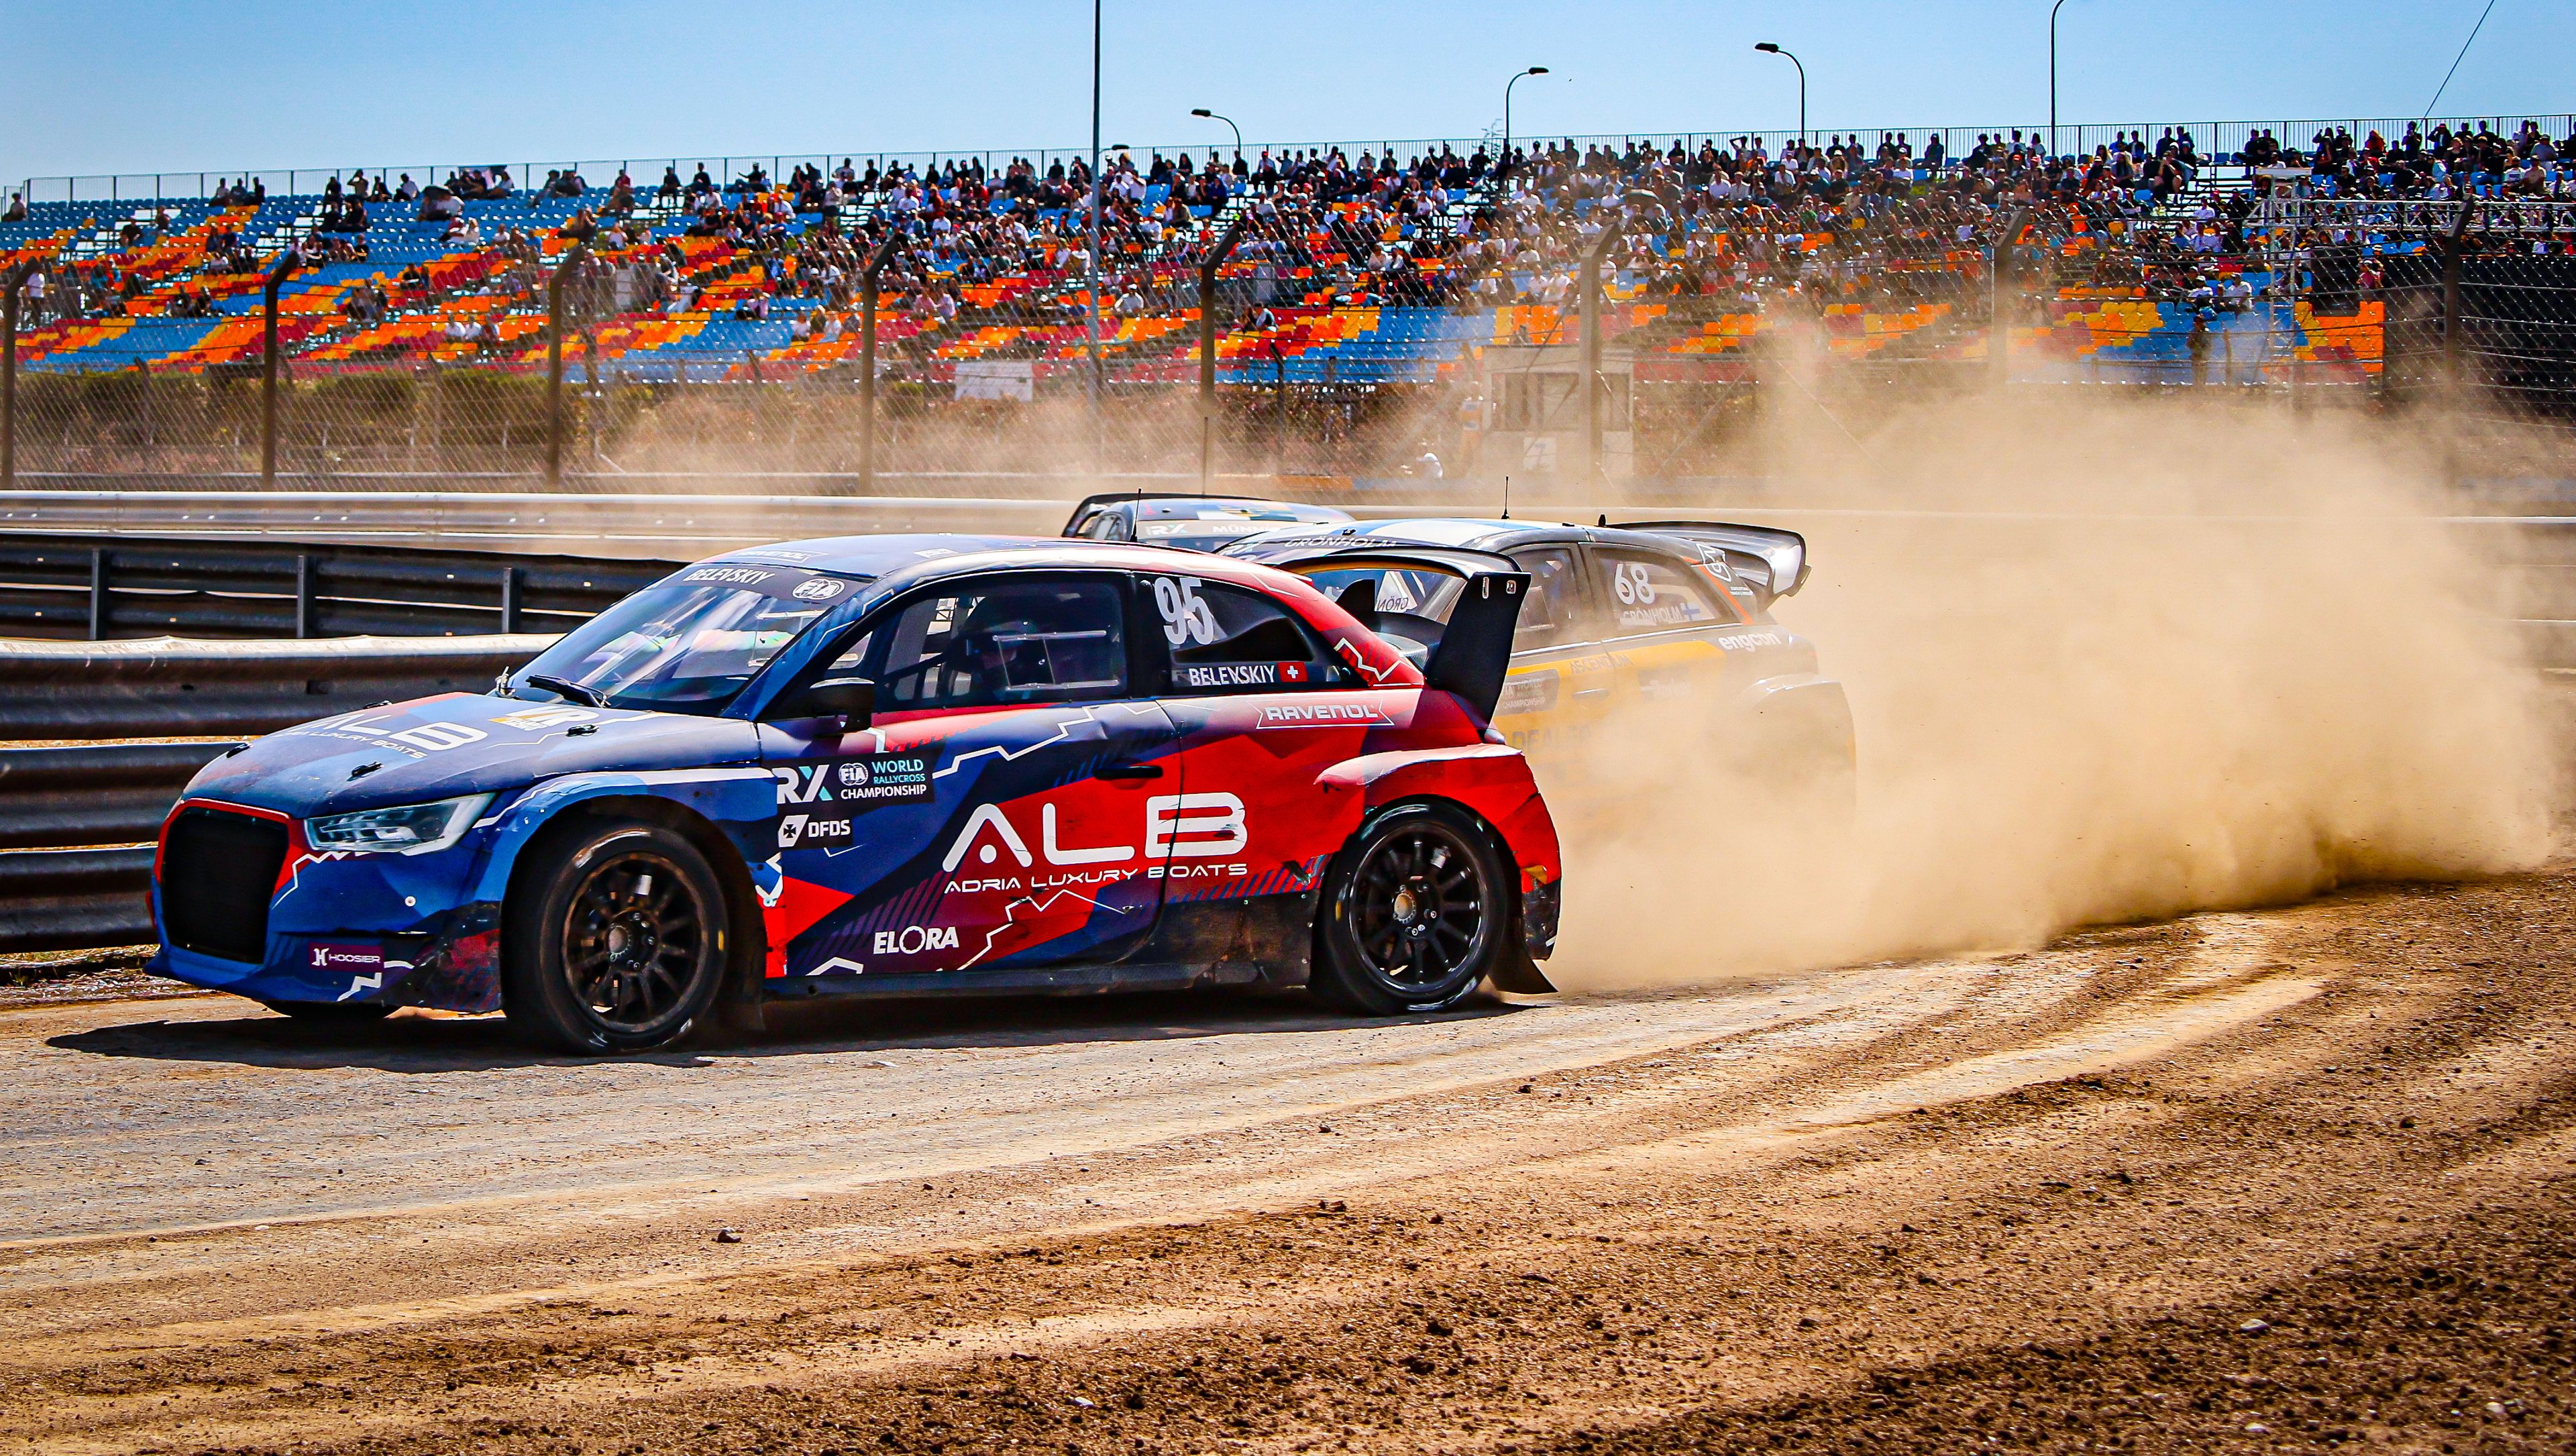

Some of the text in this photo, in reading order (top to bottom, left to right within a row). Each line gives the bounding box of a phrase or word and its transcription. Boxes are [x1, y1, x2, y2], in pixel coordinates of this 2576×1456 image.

[683, 568, 775, 585] BELEVSKIY
[1614, 563, 1656, 605] 68
[1154, 576, 1214, 646] 95
[1188, 665, 1275, 687] BELEVSKIY
[1265, 704, 1379, 721] RAVENOL
[371, 740, 429, 759] BOATS
[871, 759, 924, 774] WORLD
[771, 764, 834, 804] RX
[873, 773, 926, 784] RALLYCROSS
[840, 785, 927, 800] CHAMPIONSHIP
[808, 819, 851, 838] DFDS
[942, 792, 1248, 873] ALB
[943, 863, 1248, 894] ADRIA LUXURY BOATS
[873, 925, 959, 955] ELORA
[328, 954, 381, 964] HOOSIER
